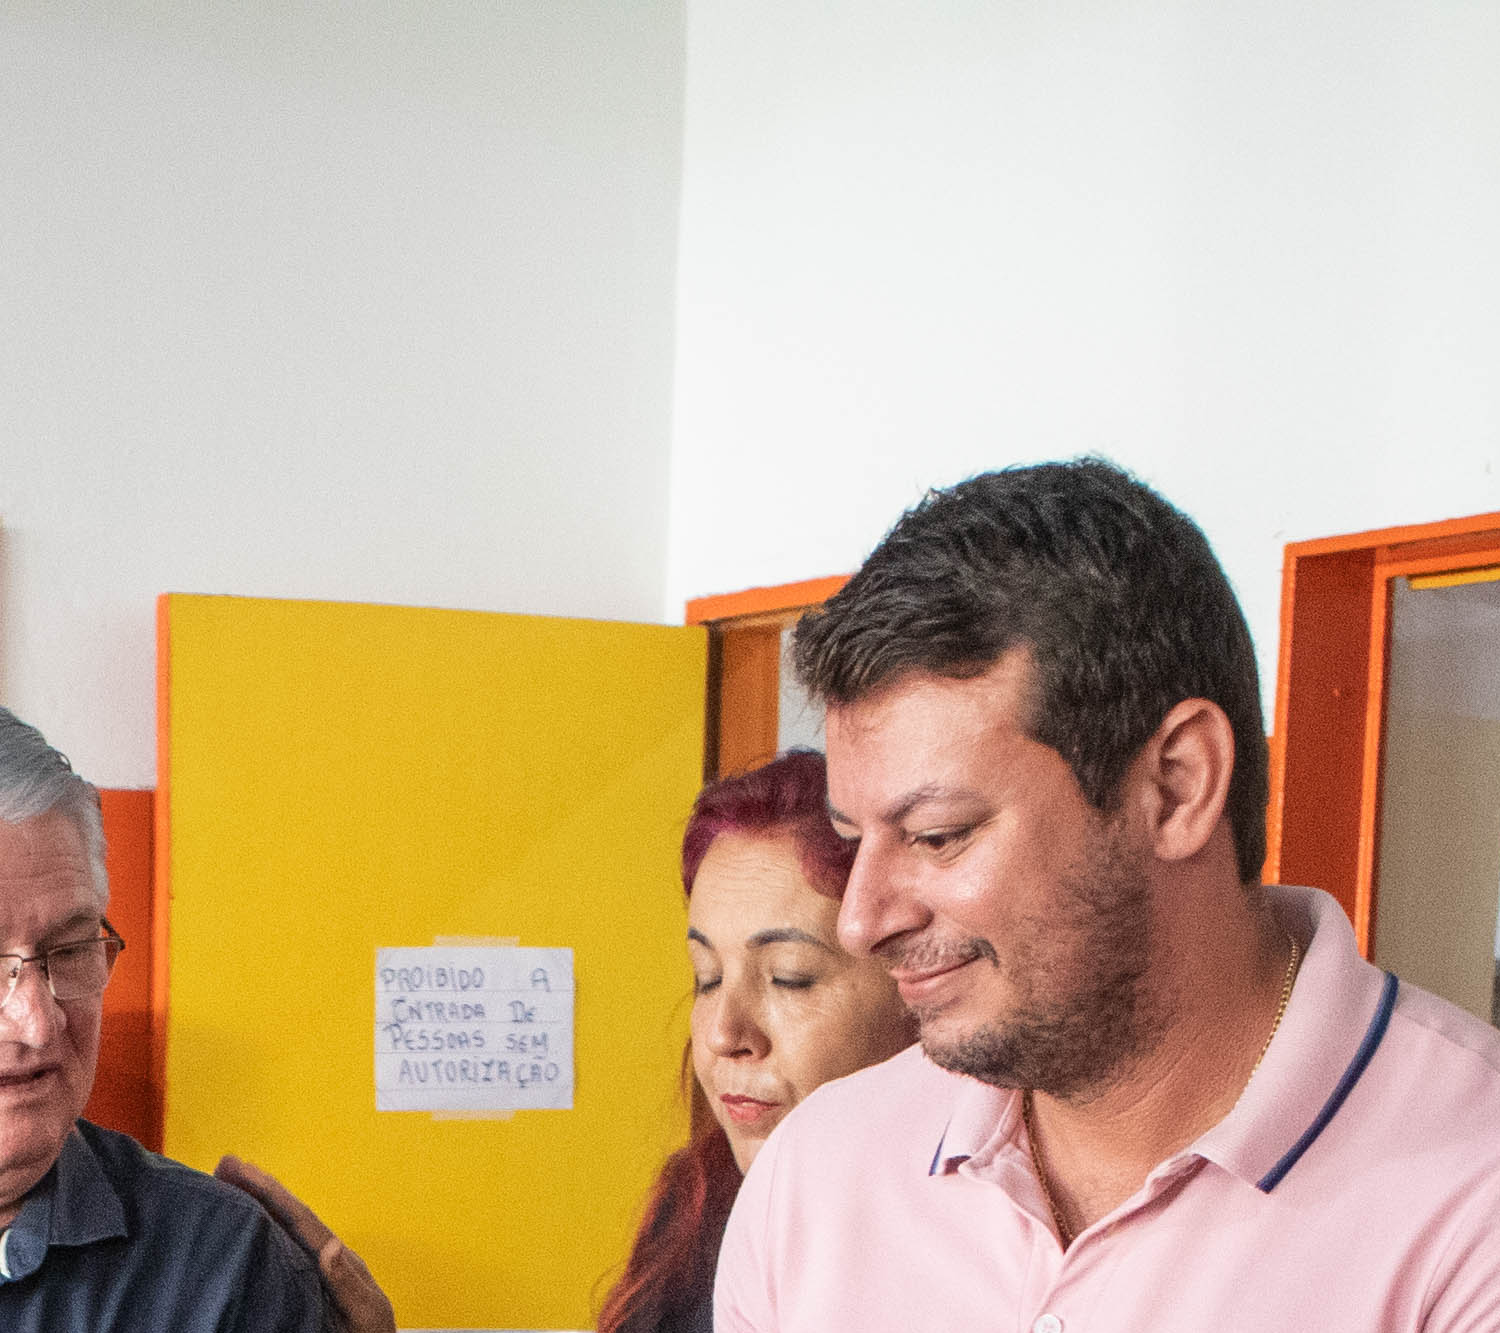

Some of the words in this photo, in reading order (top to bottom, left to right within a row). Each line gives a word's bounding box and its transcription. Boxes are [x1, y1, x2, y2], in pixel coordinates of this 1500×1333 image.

[380, 967, 485, 992] PROIBIDO
[531, 967, 550, 992] A
[391, 996, 486, 1023] ENTRADA
[508, 1000, 536, 1023] DE
[384, 1023, 486, 1050] PESSOAS
[505, 1031, 548, 1053] SEM
[399, 1056, 560, 1088] AUTORIZAÇÃO
